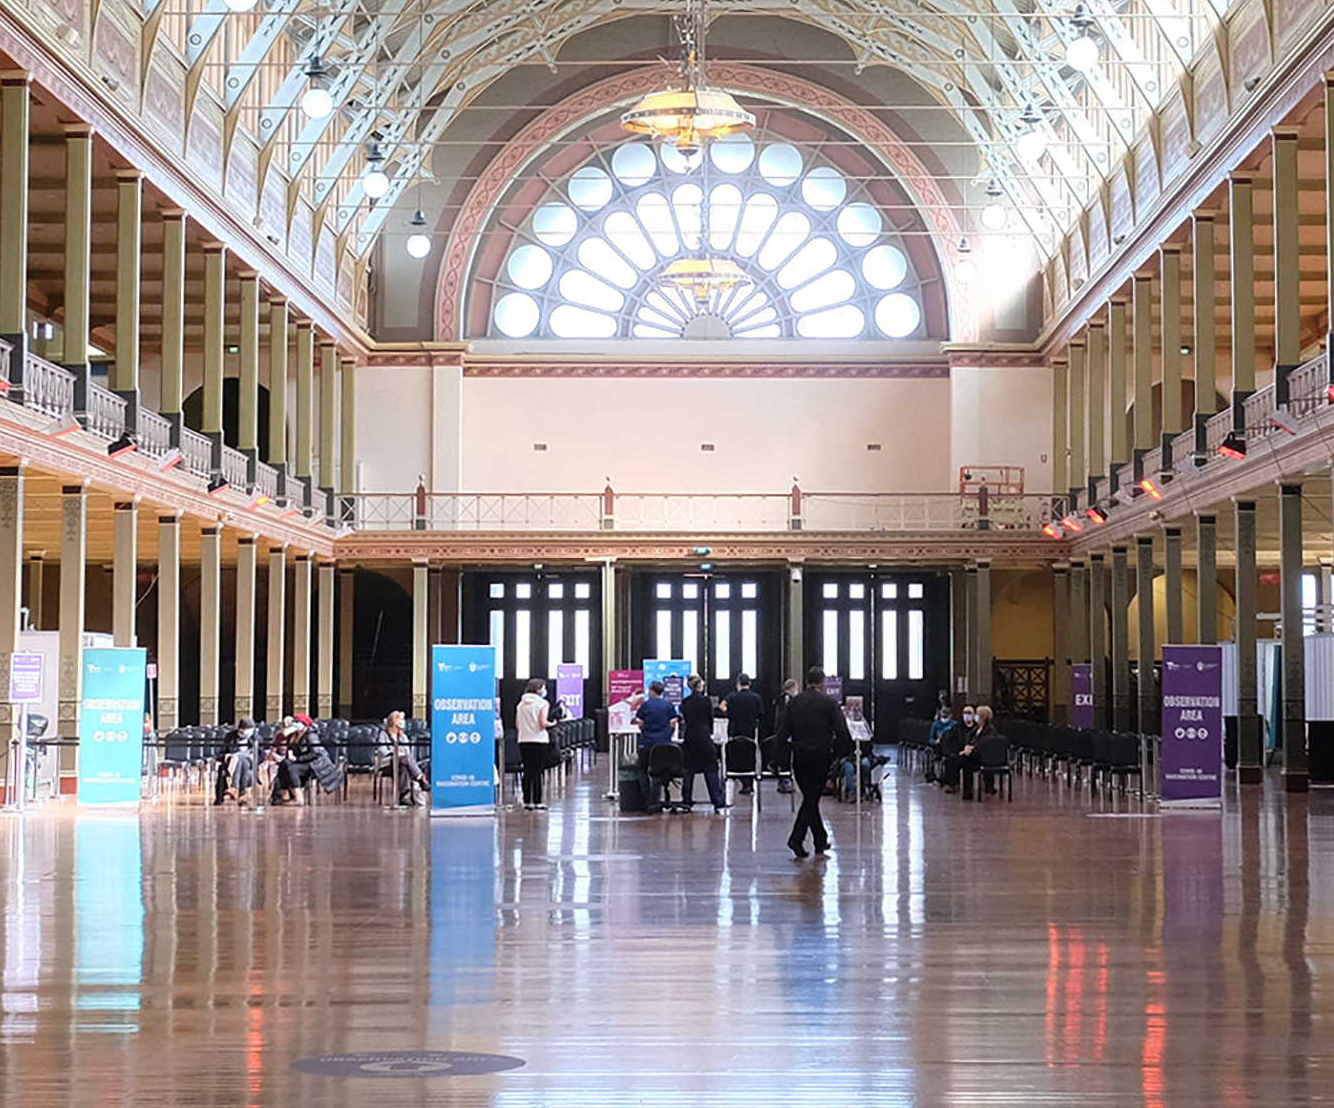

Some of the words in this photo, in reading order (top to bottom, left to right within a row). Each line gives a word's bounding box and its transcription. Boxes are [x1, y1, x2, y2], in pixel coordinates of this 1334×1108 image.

[434, 698, 493, 711] OBSERVATION
[1075, 694, 1094, 706] EXI
[1163, 695, 1220, 708] OBSERVATION
[451, 712, 476, 725] AREA
[1180, 709, 1203, 721] AREA
